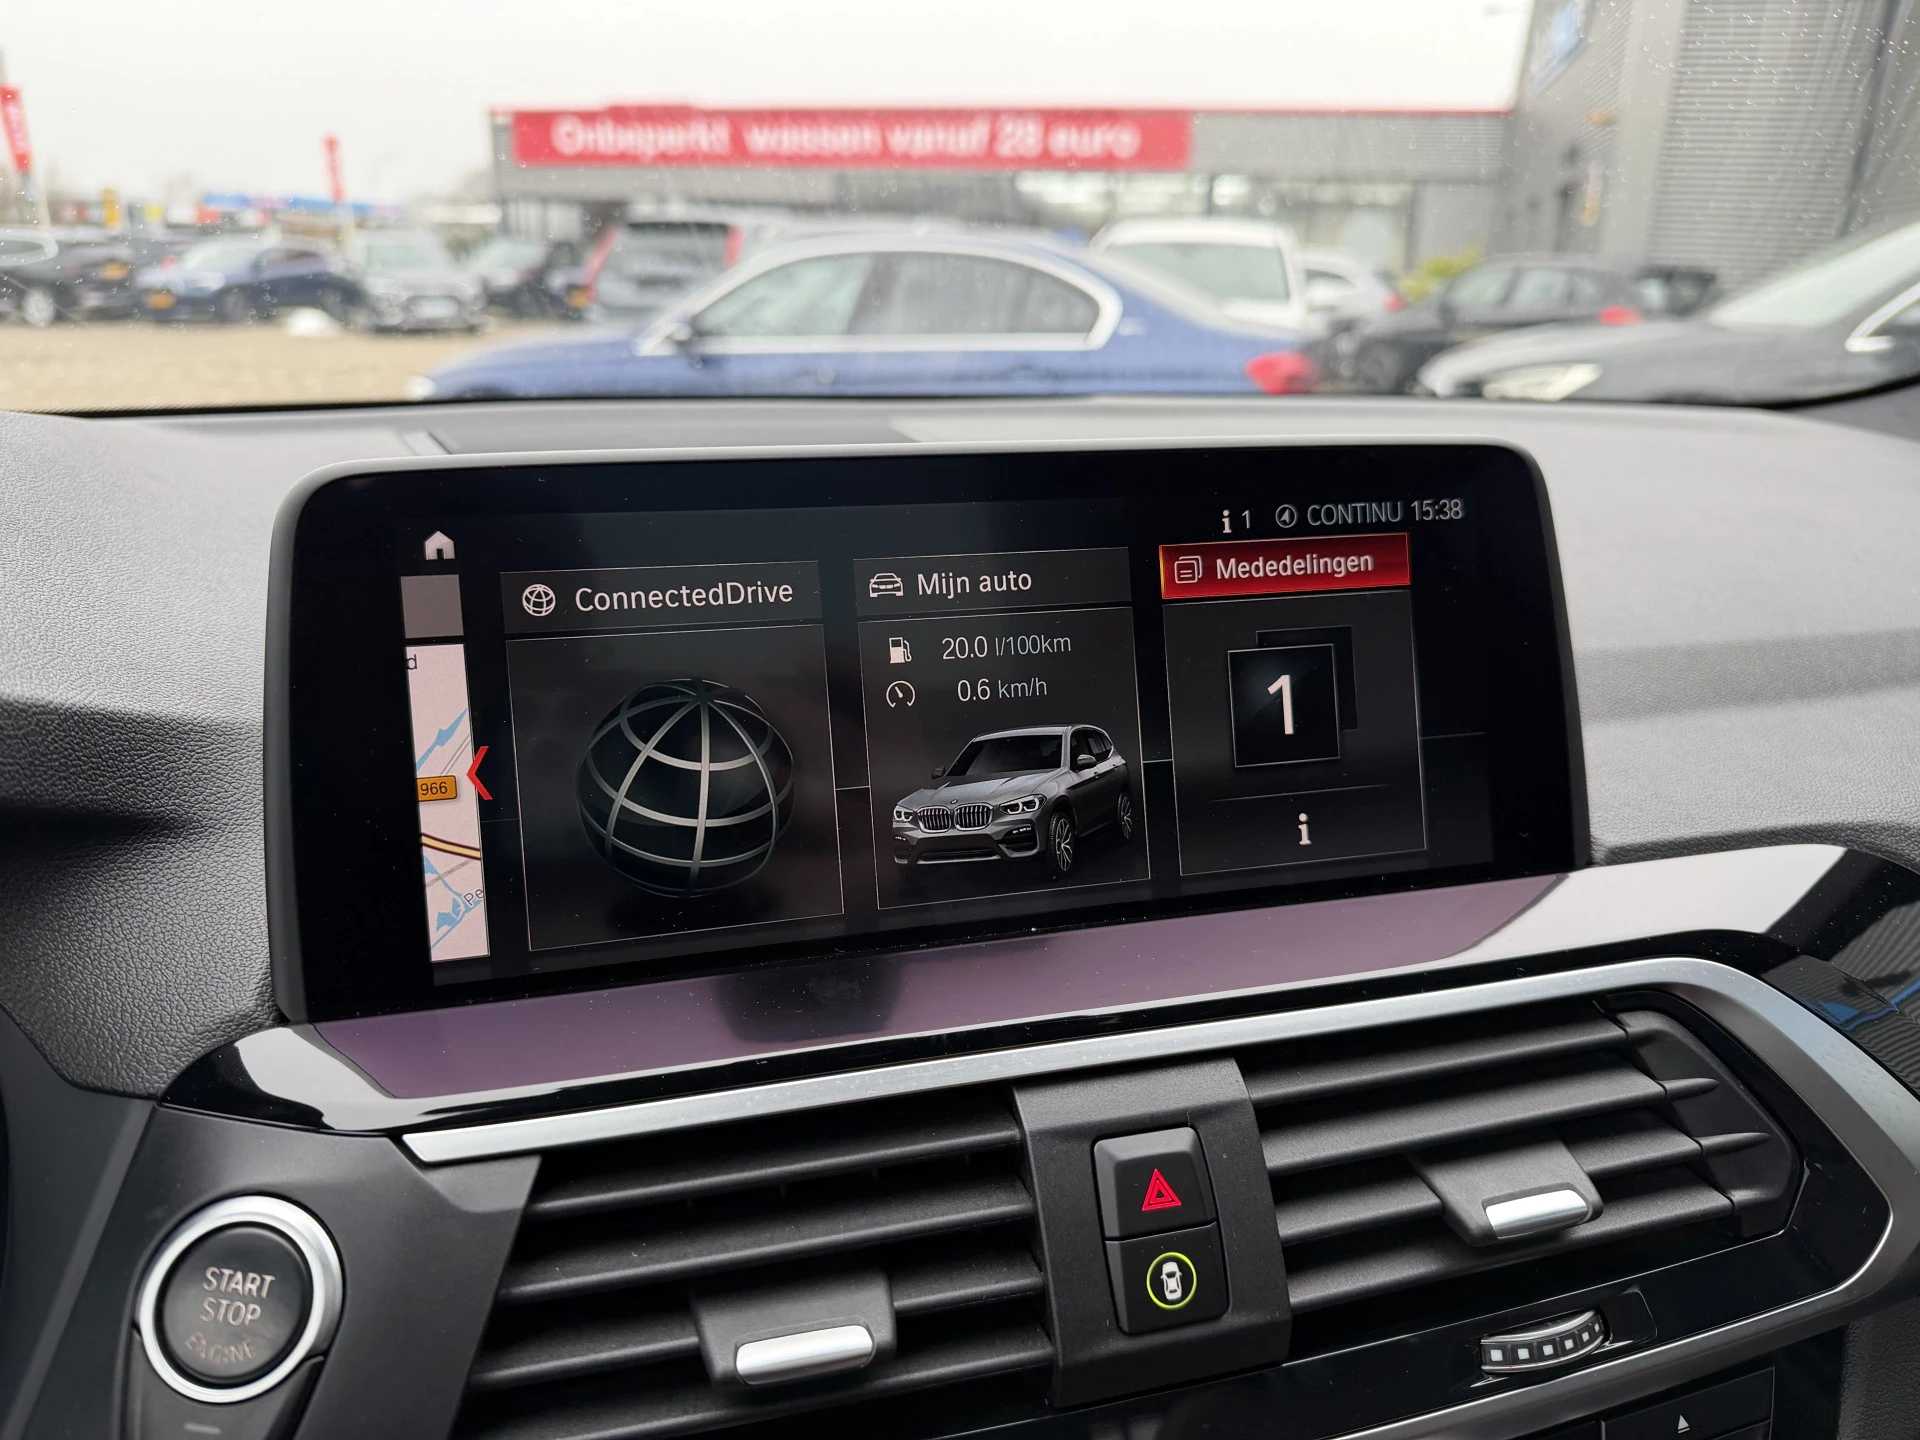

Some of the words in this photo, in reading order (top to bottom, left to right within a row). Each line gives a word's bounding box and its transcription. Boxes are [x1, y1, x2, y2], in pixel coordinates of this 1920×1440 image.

[552, 113, 731, 161] Onbeperkt
[742, 121, 882, 157] wassen
[1048, 119, 1142, 160] euro
[1241, 509, 1251, 530] 1
[1307, 501, 1402, 526] CONTINU
[1410, 498, 1464, 522] 15:38
[1215, 553, 1374, 580] Mededelingen
[574, 580, 794, 612] ConnectedDrive
[917, 571, 970, 600] Mijn
[979, 570, 1032, 593] auto
[941, 635, 988, 660] 20.0
[995, 634, 1072, 657] l/100km
[957, 678, 991, 702] 0.6
[998, 677, 1048, 699] km/h
[1267, 674, 1295, 735] 1
[420, 781, 448, 796] 966
[463, 888, 484, 907] Pe
[202, 1266, 276, 1299] START
[200, 1296, 261, 1326] STOP
